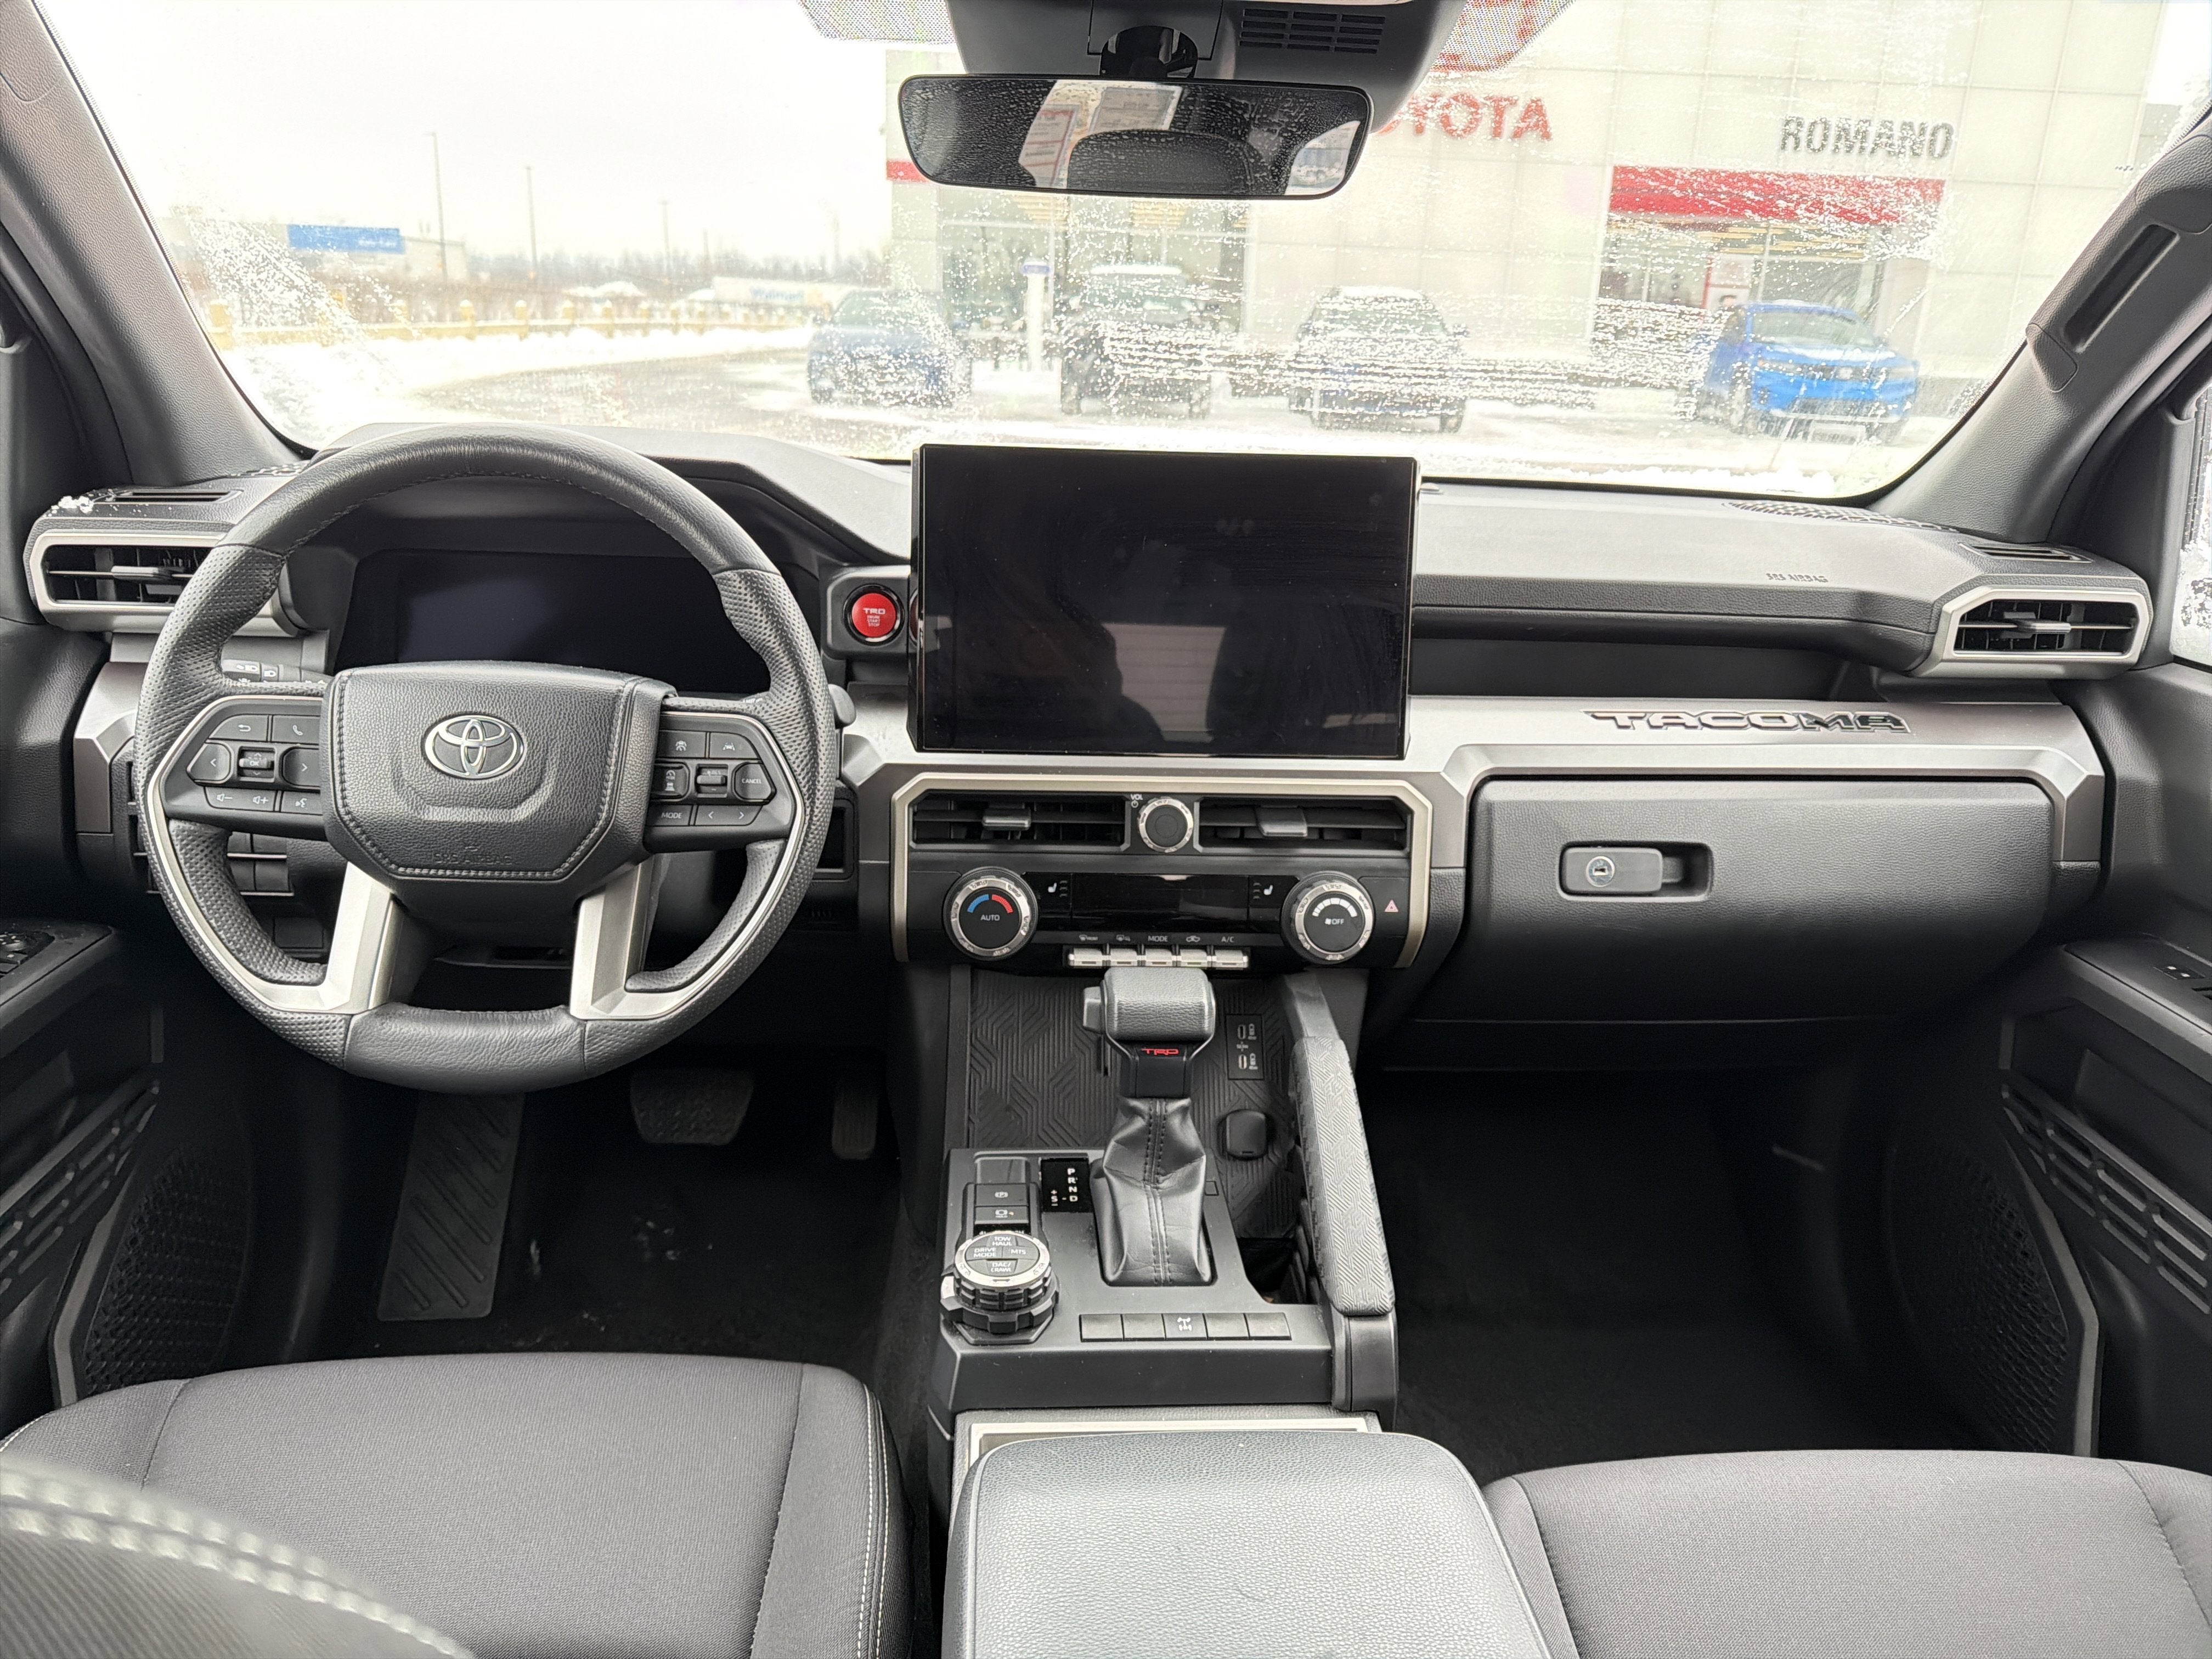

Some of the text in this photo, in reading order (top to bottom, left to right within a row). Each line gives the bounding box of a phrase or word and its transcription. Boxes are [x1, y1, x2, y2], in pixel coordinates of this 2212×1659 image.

[1379, 92, 1551, 141] YOTA
[1780, 114, 1954, 159] ROMANO
[862, 607, 886, 615] TRD
[1583, 710, 1911, 733] TACOMA
